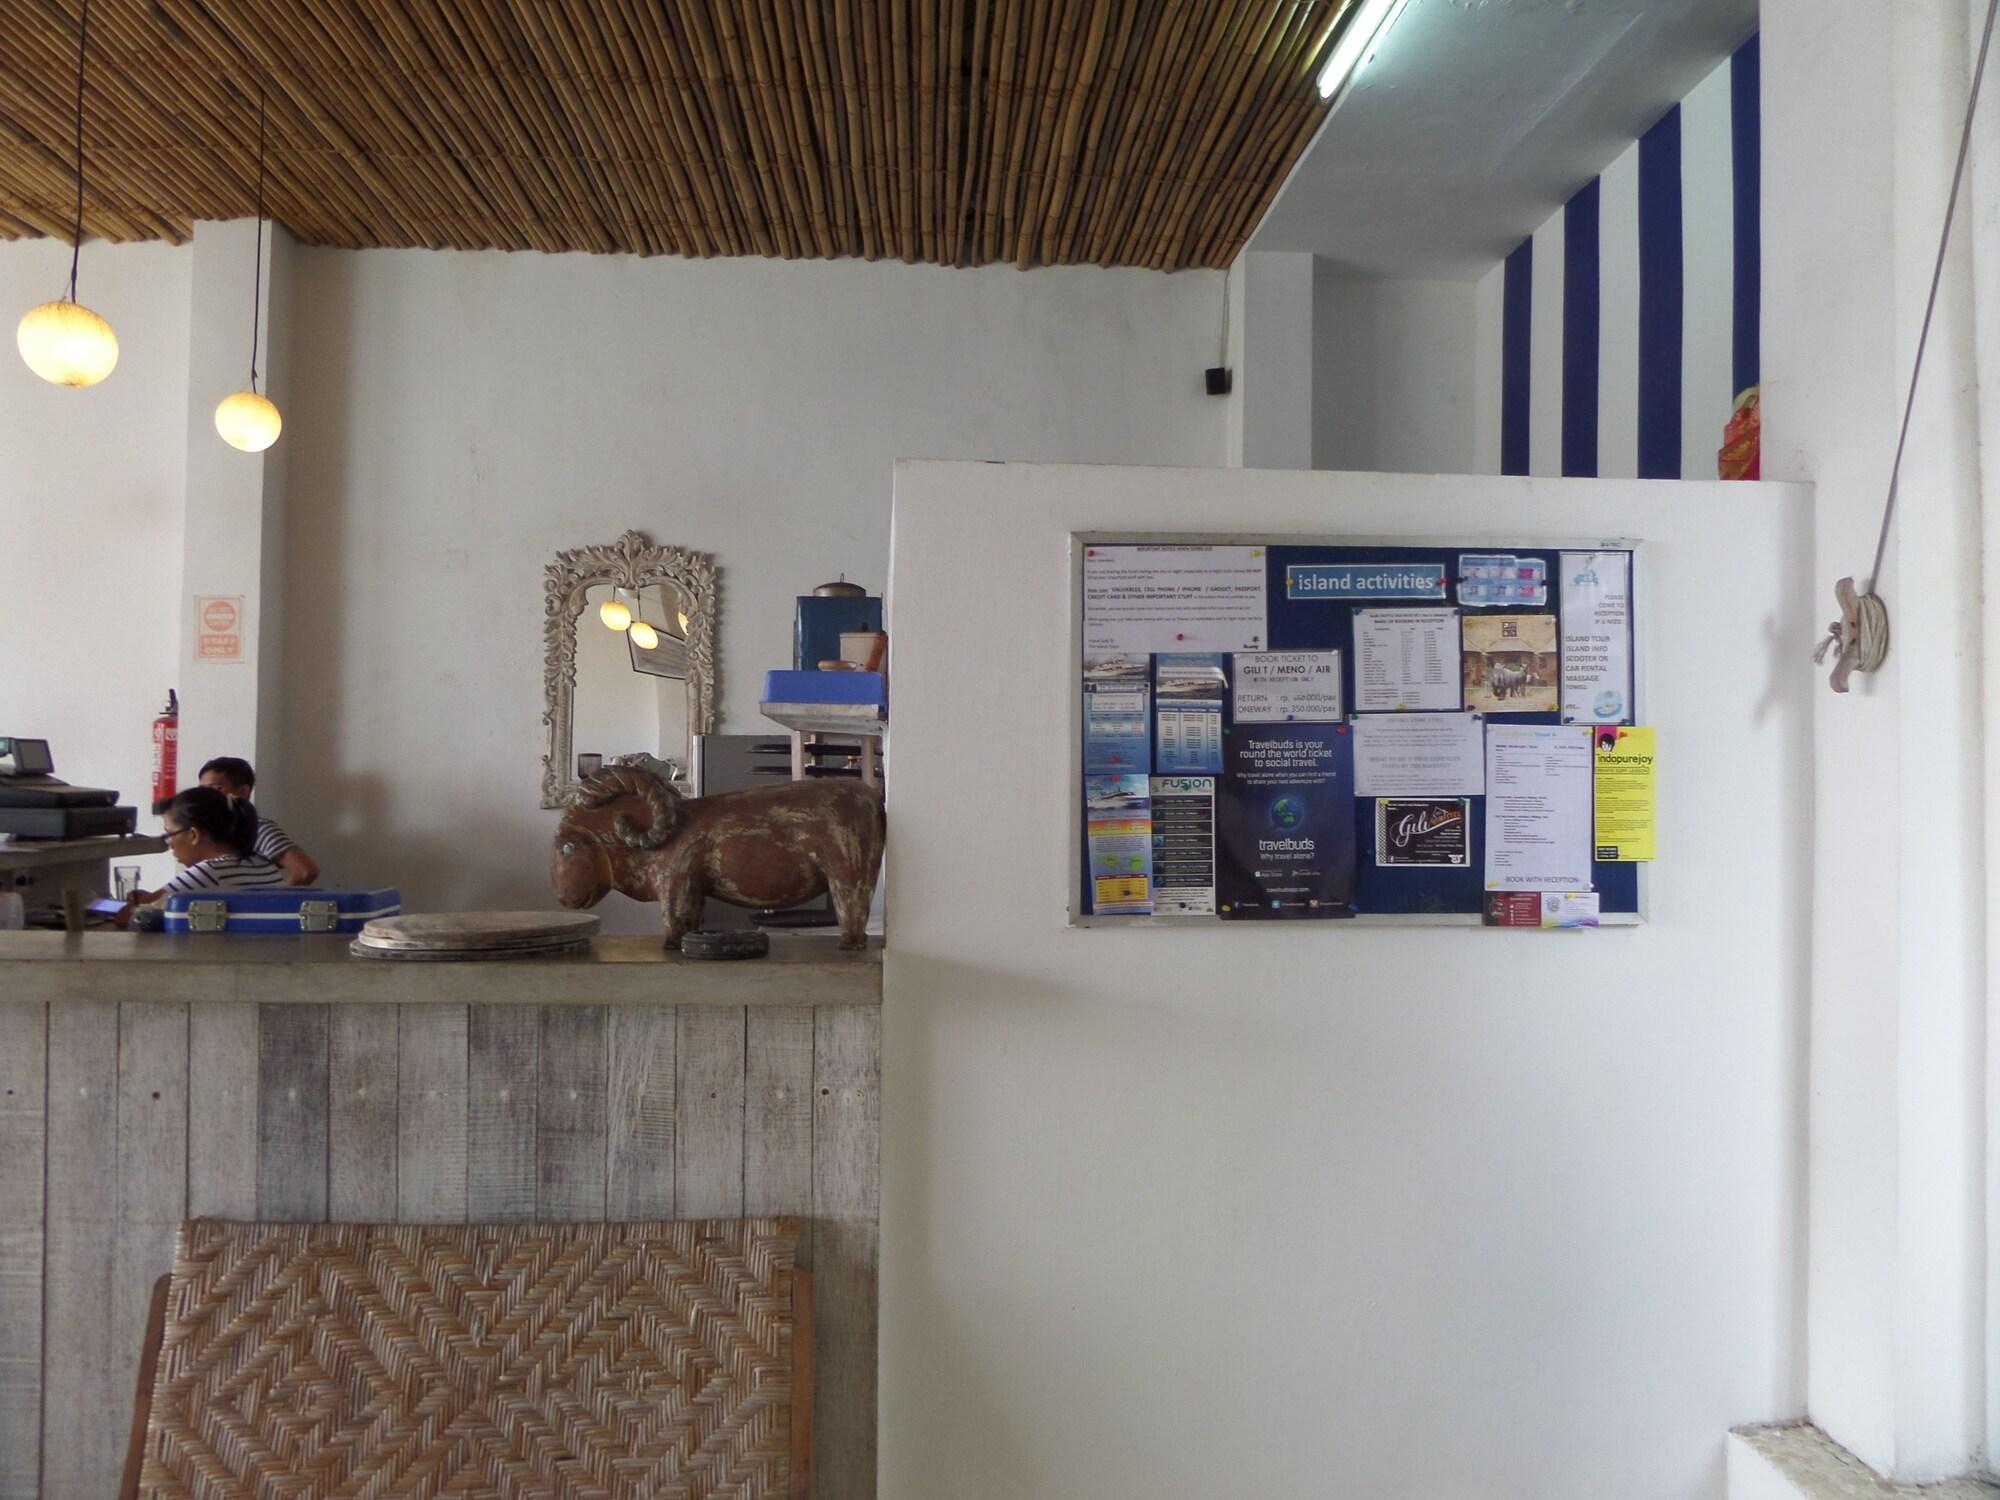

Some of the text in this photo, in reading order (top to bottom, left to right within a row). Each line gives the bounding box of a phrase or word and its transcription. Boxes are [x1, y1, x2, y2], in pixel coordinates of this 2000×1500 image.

[1299, 573, 1434, 590] island activities
[1243, 666, 1260, 674] GILI
[1261, 666, 1268, 674] T
[1276, 666, 1306, 674] MENO
[1248, 740, 1324, 752] Travelbuds is your
[1240, 749, 1332, 758] round the world ticket
[1254, 758, 1264, 768] to
[1265, 758, 1291, 768] social
[1598, 753, 1654, 766] indopurejoy
[1259, 838, 1314, 850] travelbuds
[1260, 853, 1274, 861] Why
[1294, 852, 1314, 860] alone?
